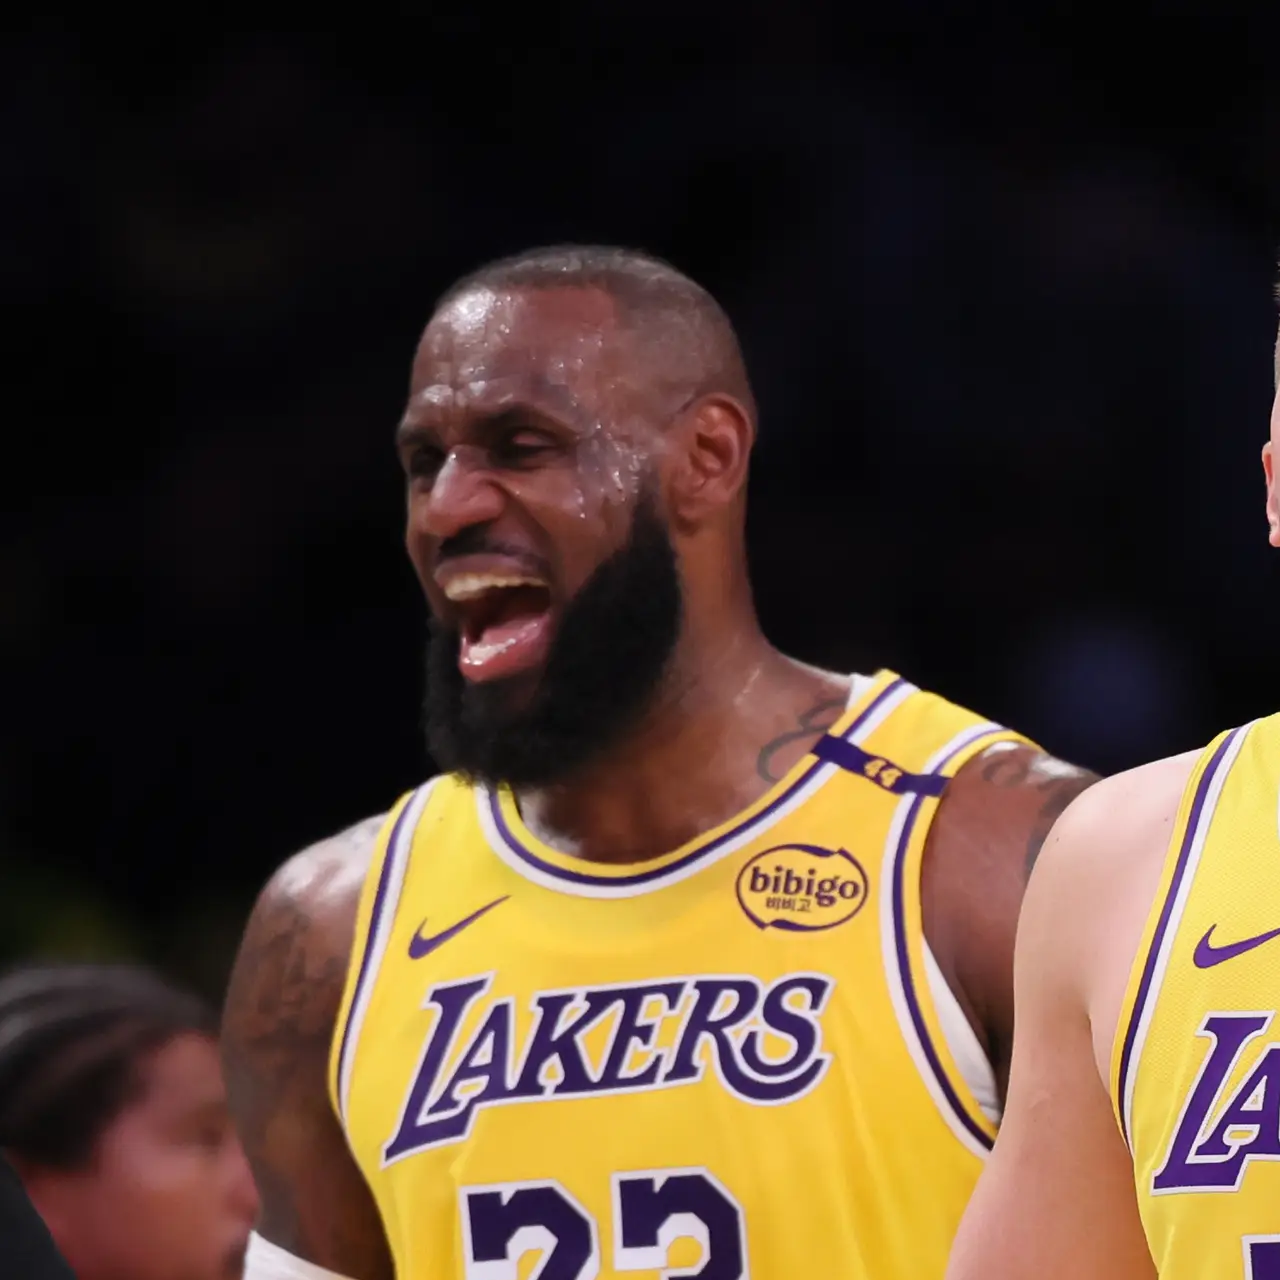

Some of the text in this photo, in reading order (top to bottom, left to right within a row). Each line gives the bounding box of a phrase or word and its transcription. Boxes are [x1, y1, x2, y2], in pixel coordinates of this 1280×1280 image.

[864, 759, 902, 788] 44
[749, 865, 860, 907] bibigo
[380, 970, 835, 1170] LAKERS
